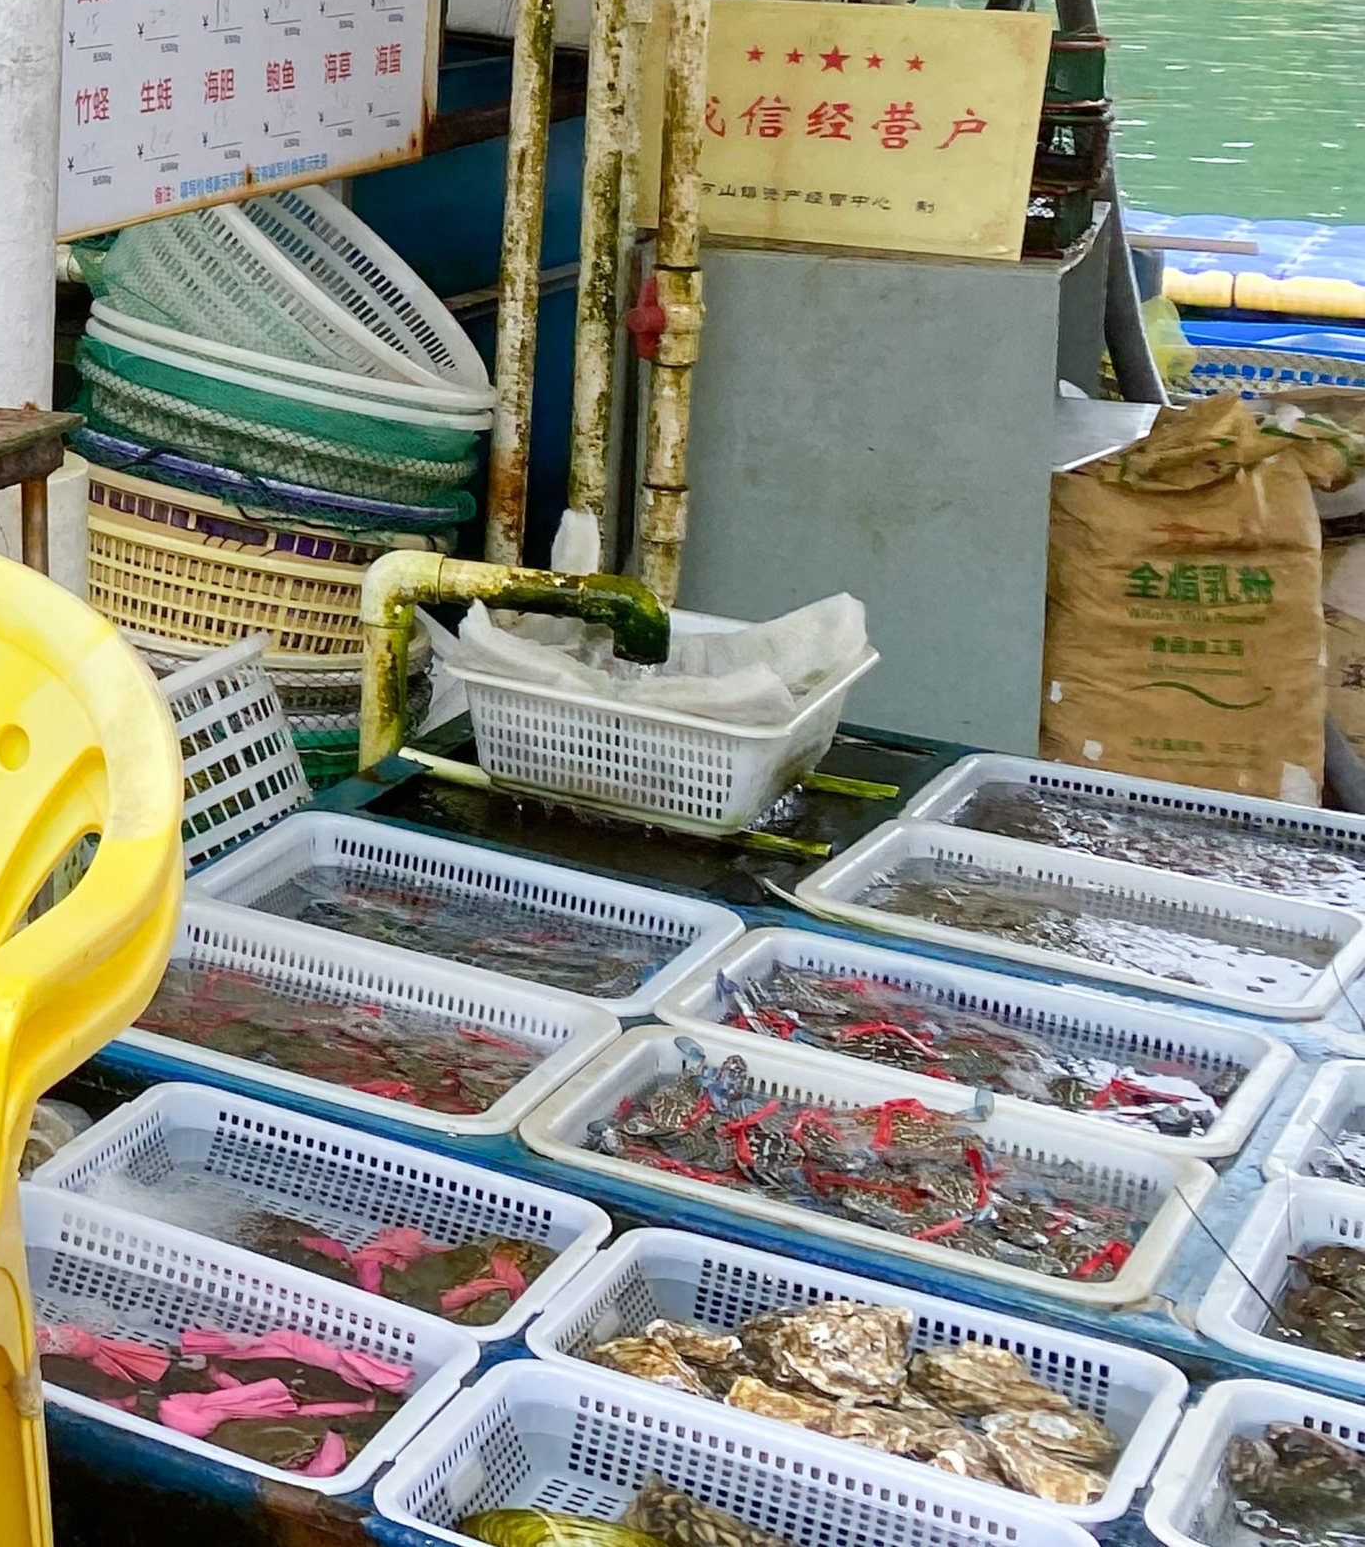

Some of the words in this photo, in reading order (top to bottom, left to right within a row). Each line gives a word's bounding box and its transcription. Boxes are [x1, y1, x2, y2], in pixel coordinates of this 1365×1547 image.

[140, 78, 172, 114] 生蚝
[1126, 561, 1274, 604] 全脂乳粉
